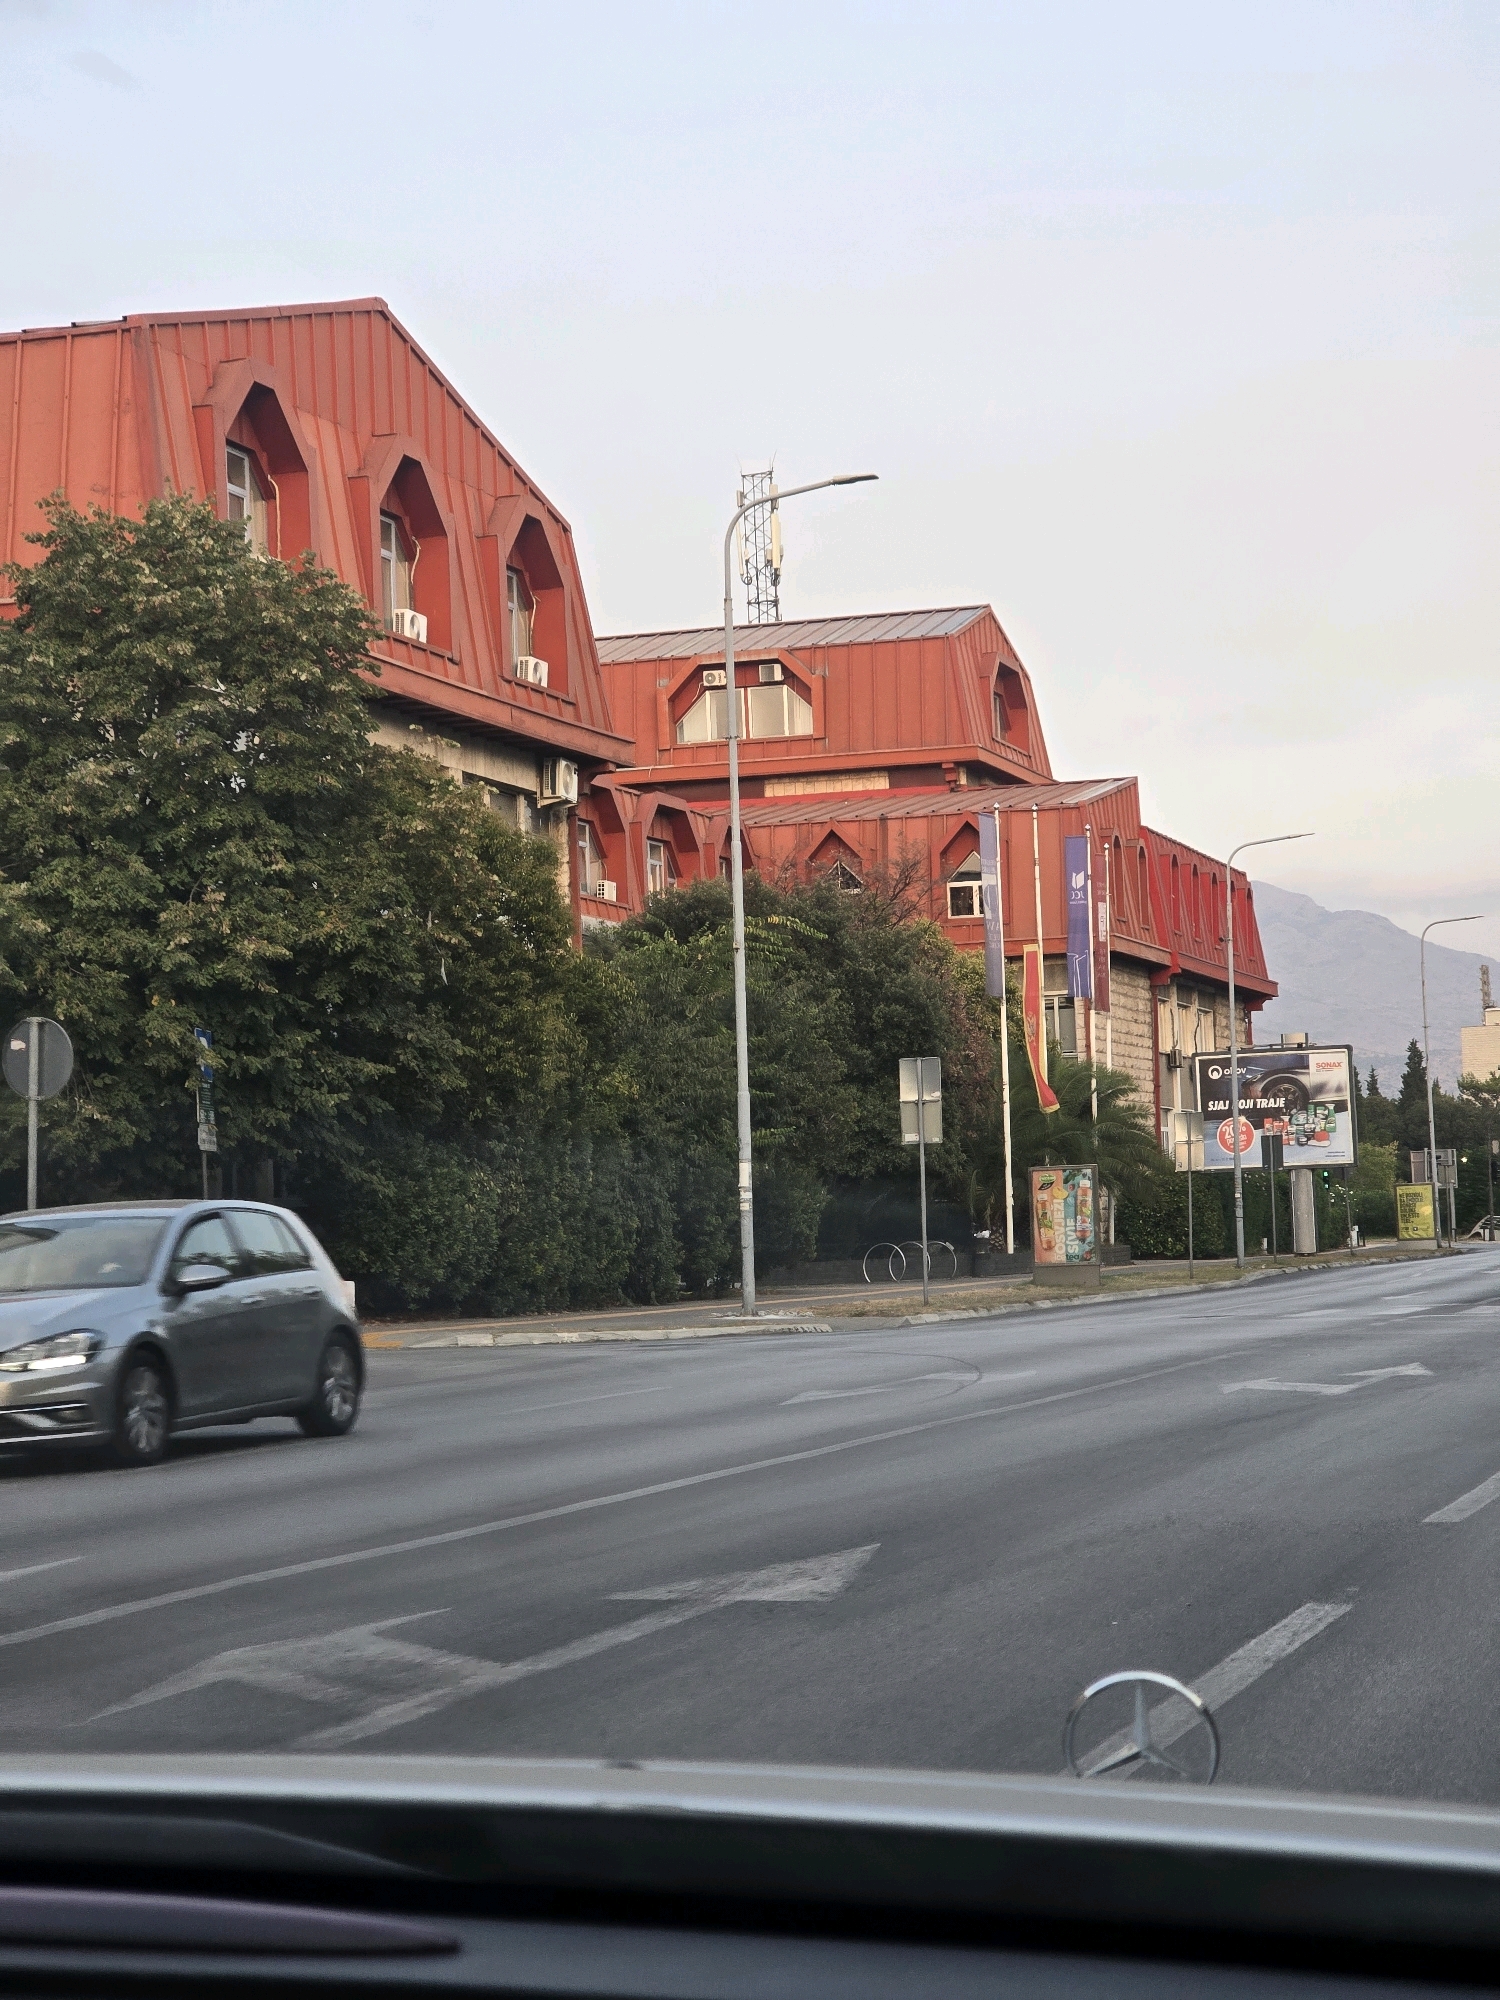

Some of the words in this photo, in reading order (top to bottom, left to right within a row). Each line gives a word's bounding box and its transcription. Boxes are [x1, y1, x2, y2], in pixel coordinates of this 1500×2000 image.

[1315, 1061, 1343, 1069] SONAX
[1208, 1100, 1229, 1111] SJAJ
[1256, 1098, 1286, 1109] TRAJE
[1066, 1253, 1080, 1261] tea
